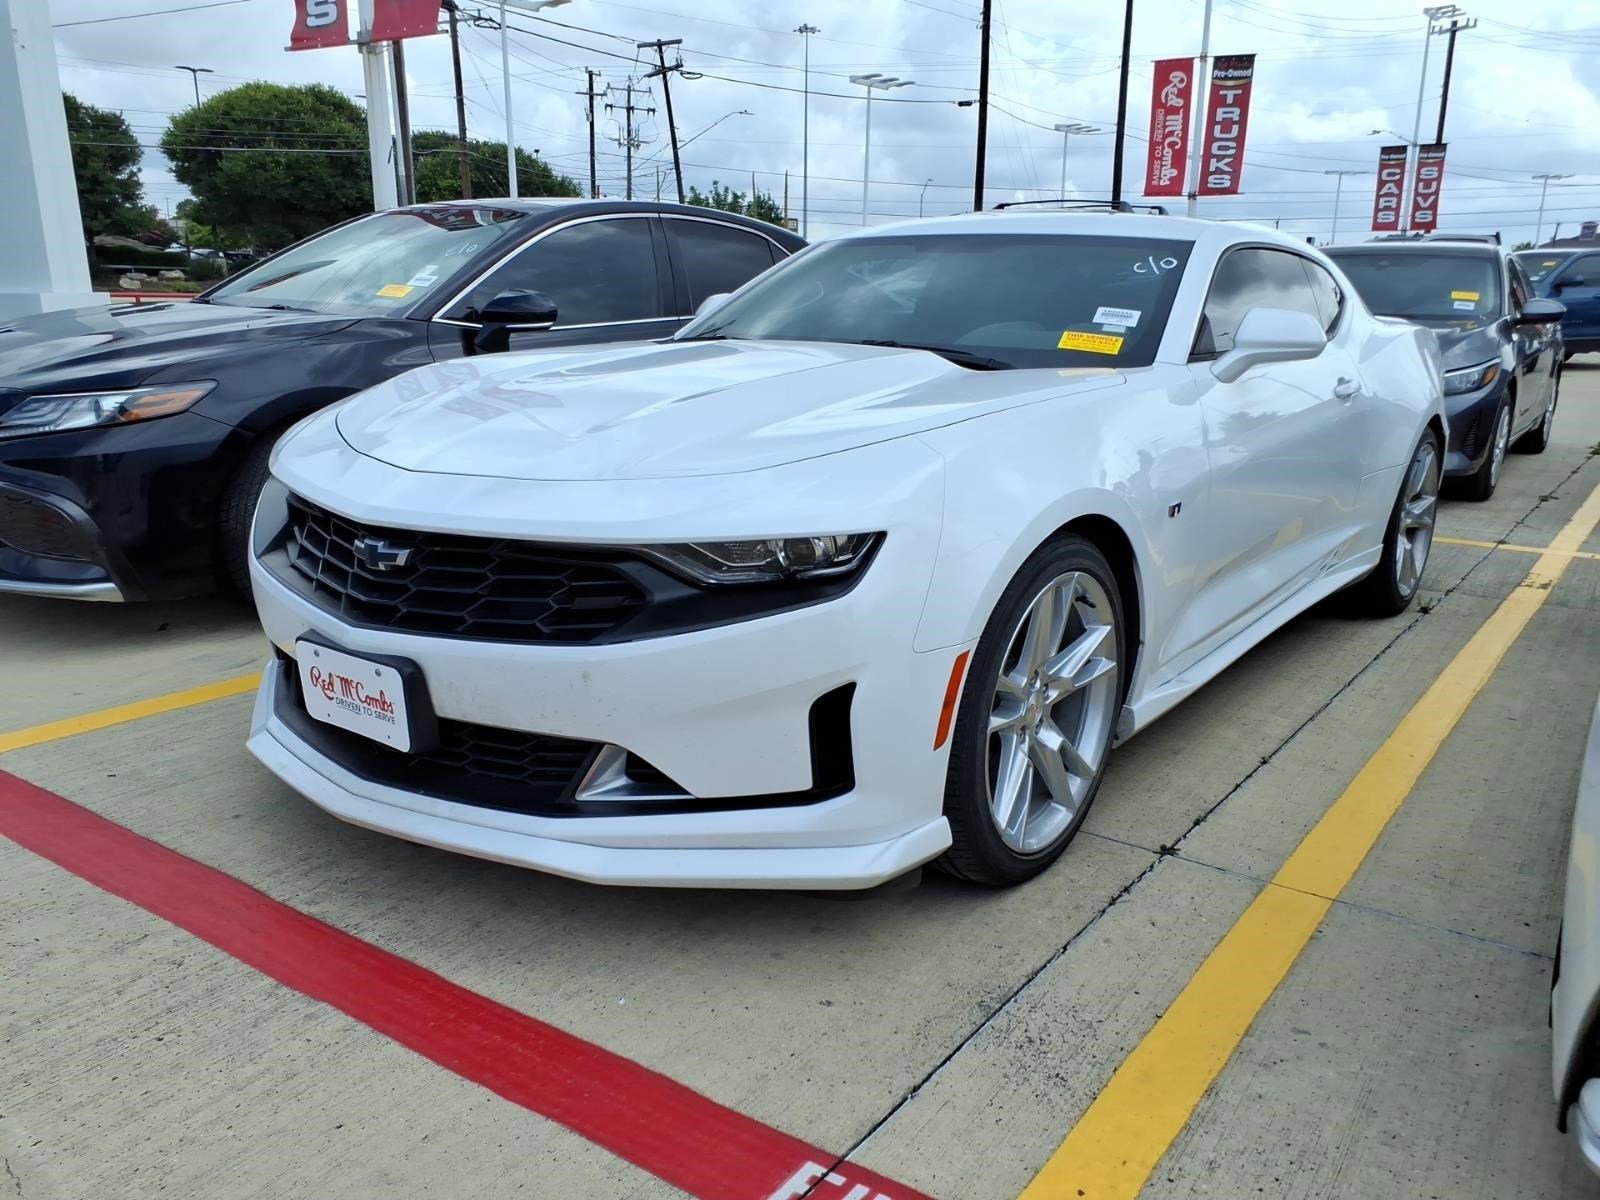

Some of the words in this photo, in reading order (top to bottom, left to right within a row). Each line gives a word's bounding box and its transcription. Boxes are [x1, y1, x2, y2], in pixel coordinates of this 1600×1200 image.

[1161, 71, 1187, 107] Red
[1213, 69, 1252, 78] Pre-Owned
[1154, 108, 1164, 142] DRIVEN
[1207, 89, 1242, 189] TRUCKS
[1154, 145, 1162, 158] TO
[1152, 160, 1160, 186] SERVE
[1376, 168, 1401, 223] CARS
[1414, 167, 1439, 223] SUVS
[310, 666, 336, 701] Red
[335, 674, 395, 715] McCombs
[336, 697, 361, 712] DRIVEN
[362, 707, 373, 716] TO
[374, 711, 396, 725] SERVE
